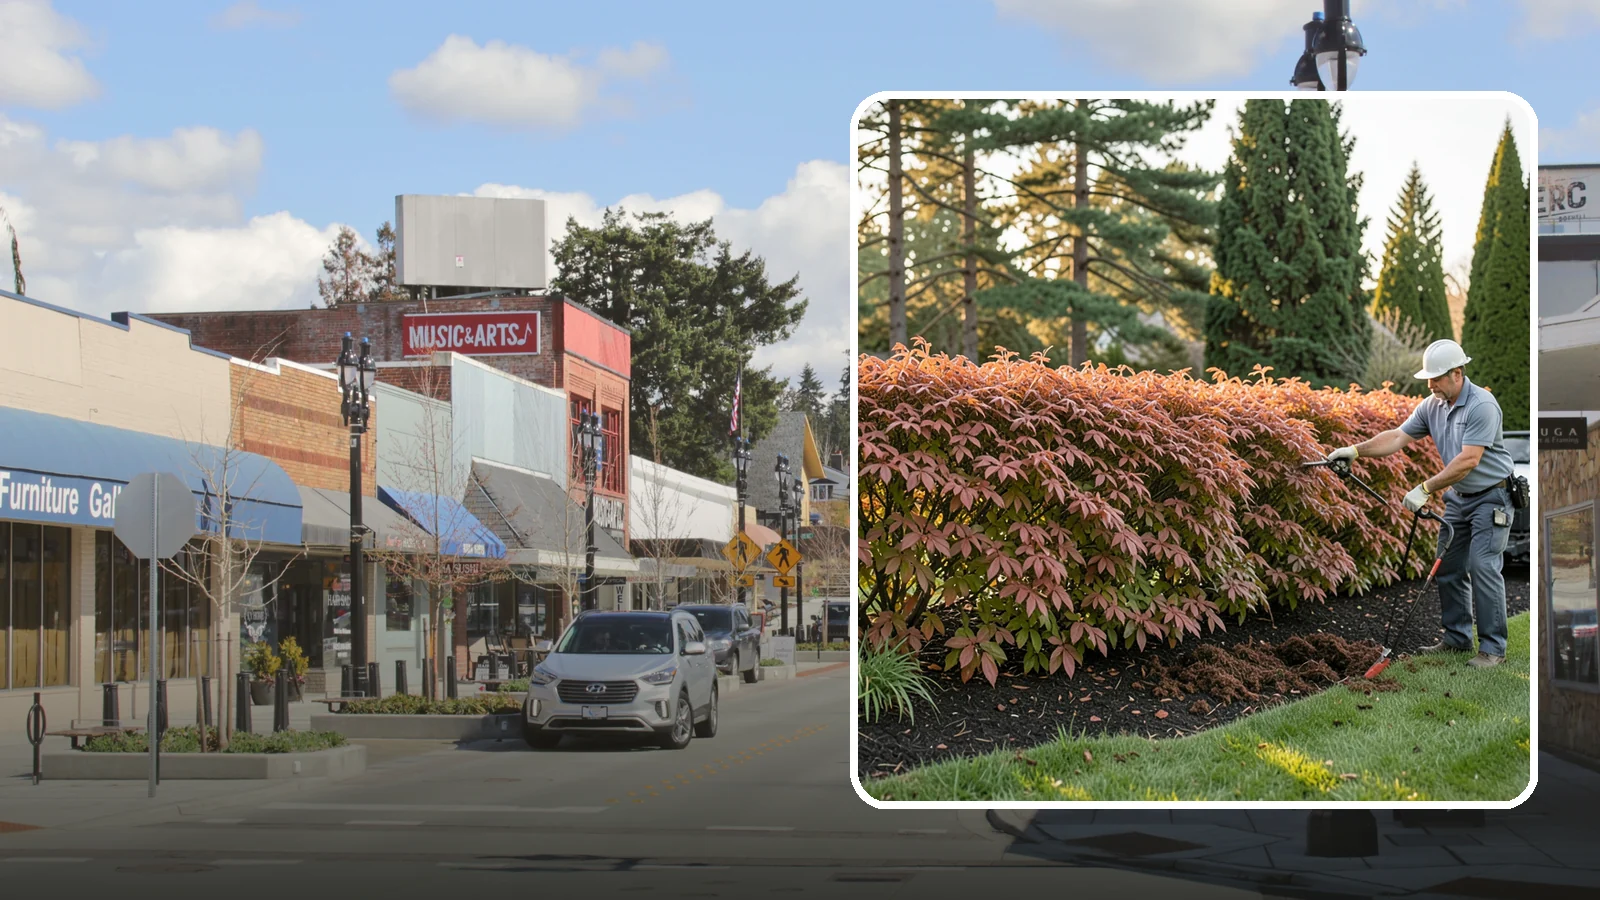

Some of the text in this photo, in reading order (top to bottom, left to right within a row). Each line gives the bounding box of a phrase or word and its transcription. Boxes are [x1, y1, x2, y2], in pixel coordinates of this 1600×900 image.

[408, 323, 520, 349] MUSIC&ARTS
[1540, 427, 1578, 437] UGA
[1551, 436, 1579, 444] Framing
[0, 471, 121, 519] Furniture Gal
[453, 563, 479, 574] SUSHI
